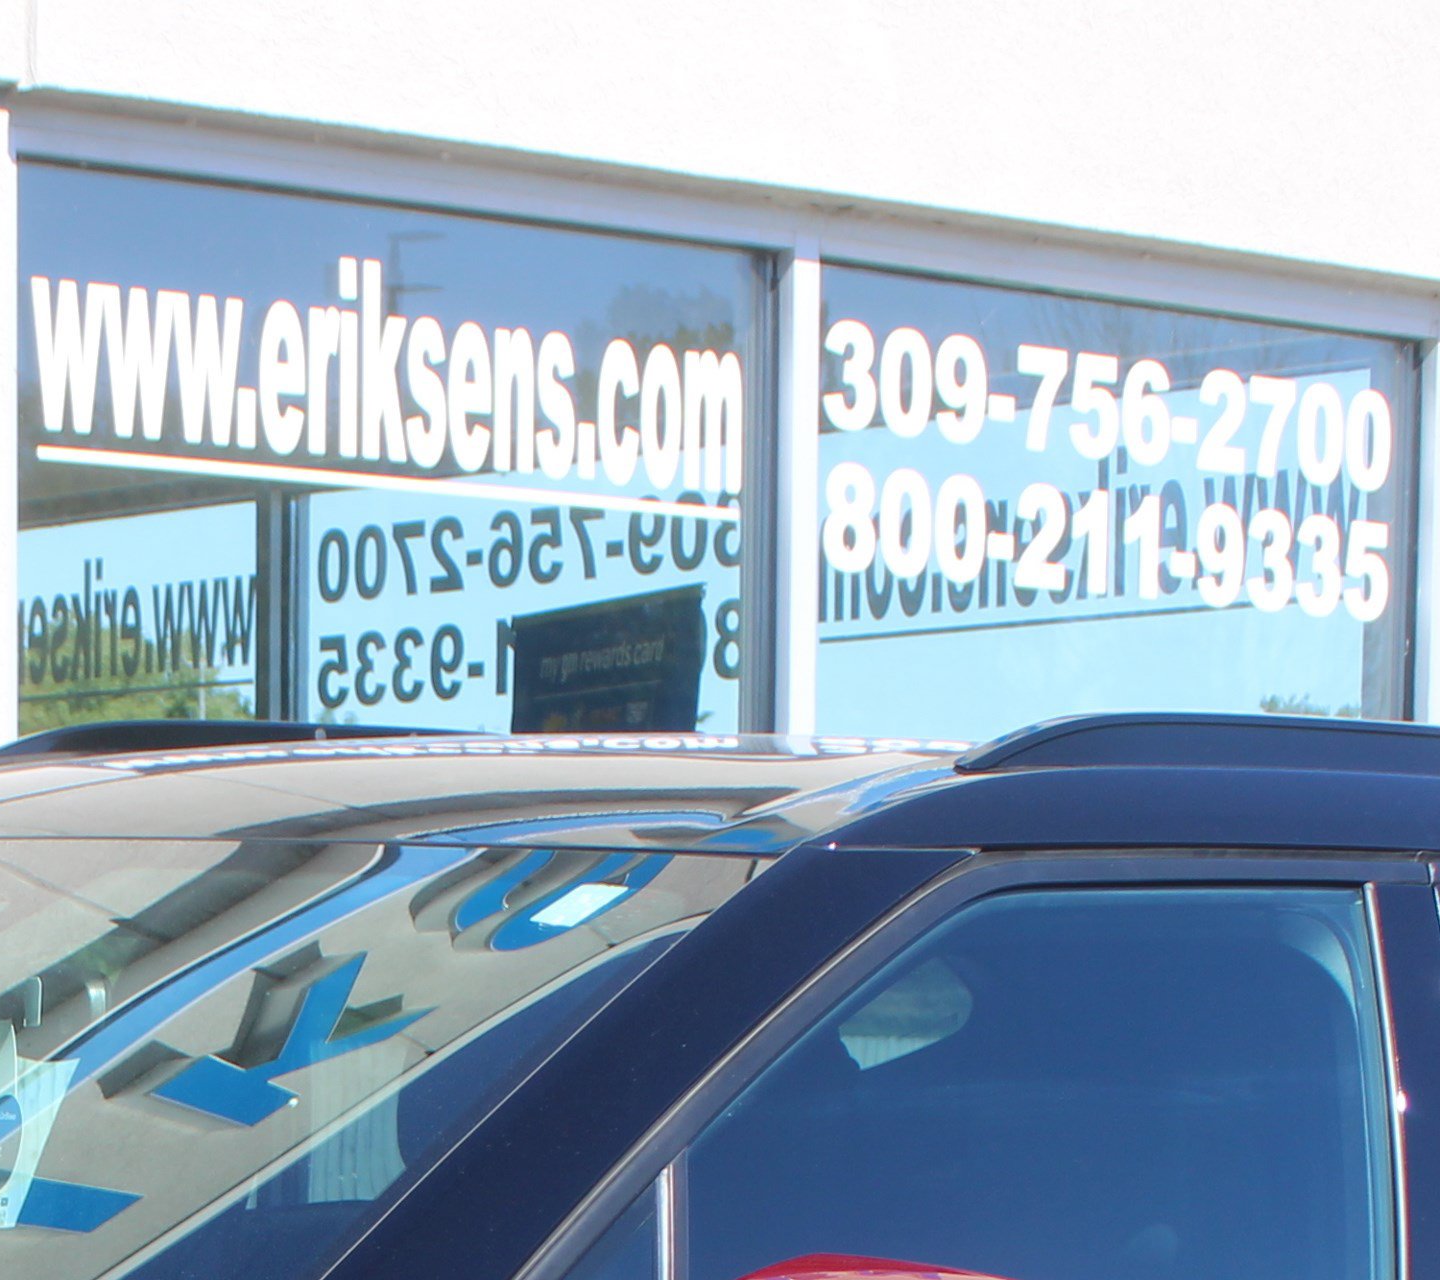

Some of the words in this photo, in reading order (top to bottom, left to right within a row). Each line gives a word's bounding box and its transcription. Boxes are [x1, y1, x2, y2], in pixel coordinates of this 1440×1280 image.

[30, 256, 744, 495] www.eriksens.com
[822, 319, 1392, 493] 309-756-2700
[822, 459, 1390, 623] 800-211-9335
